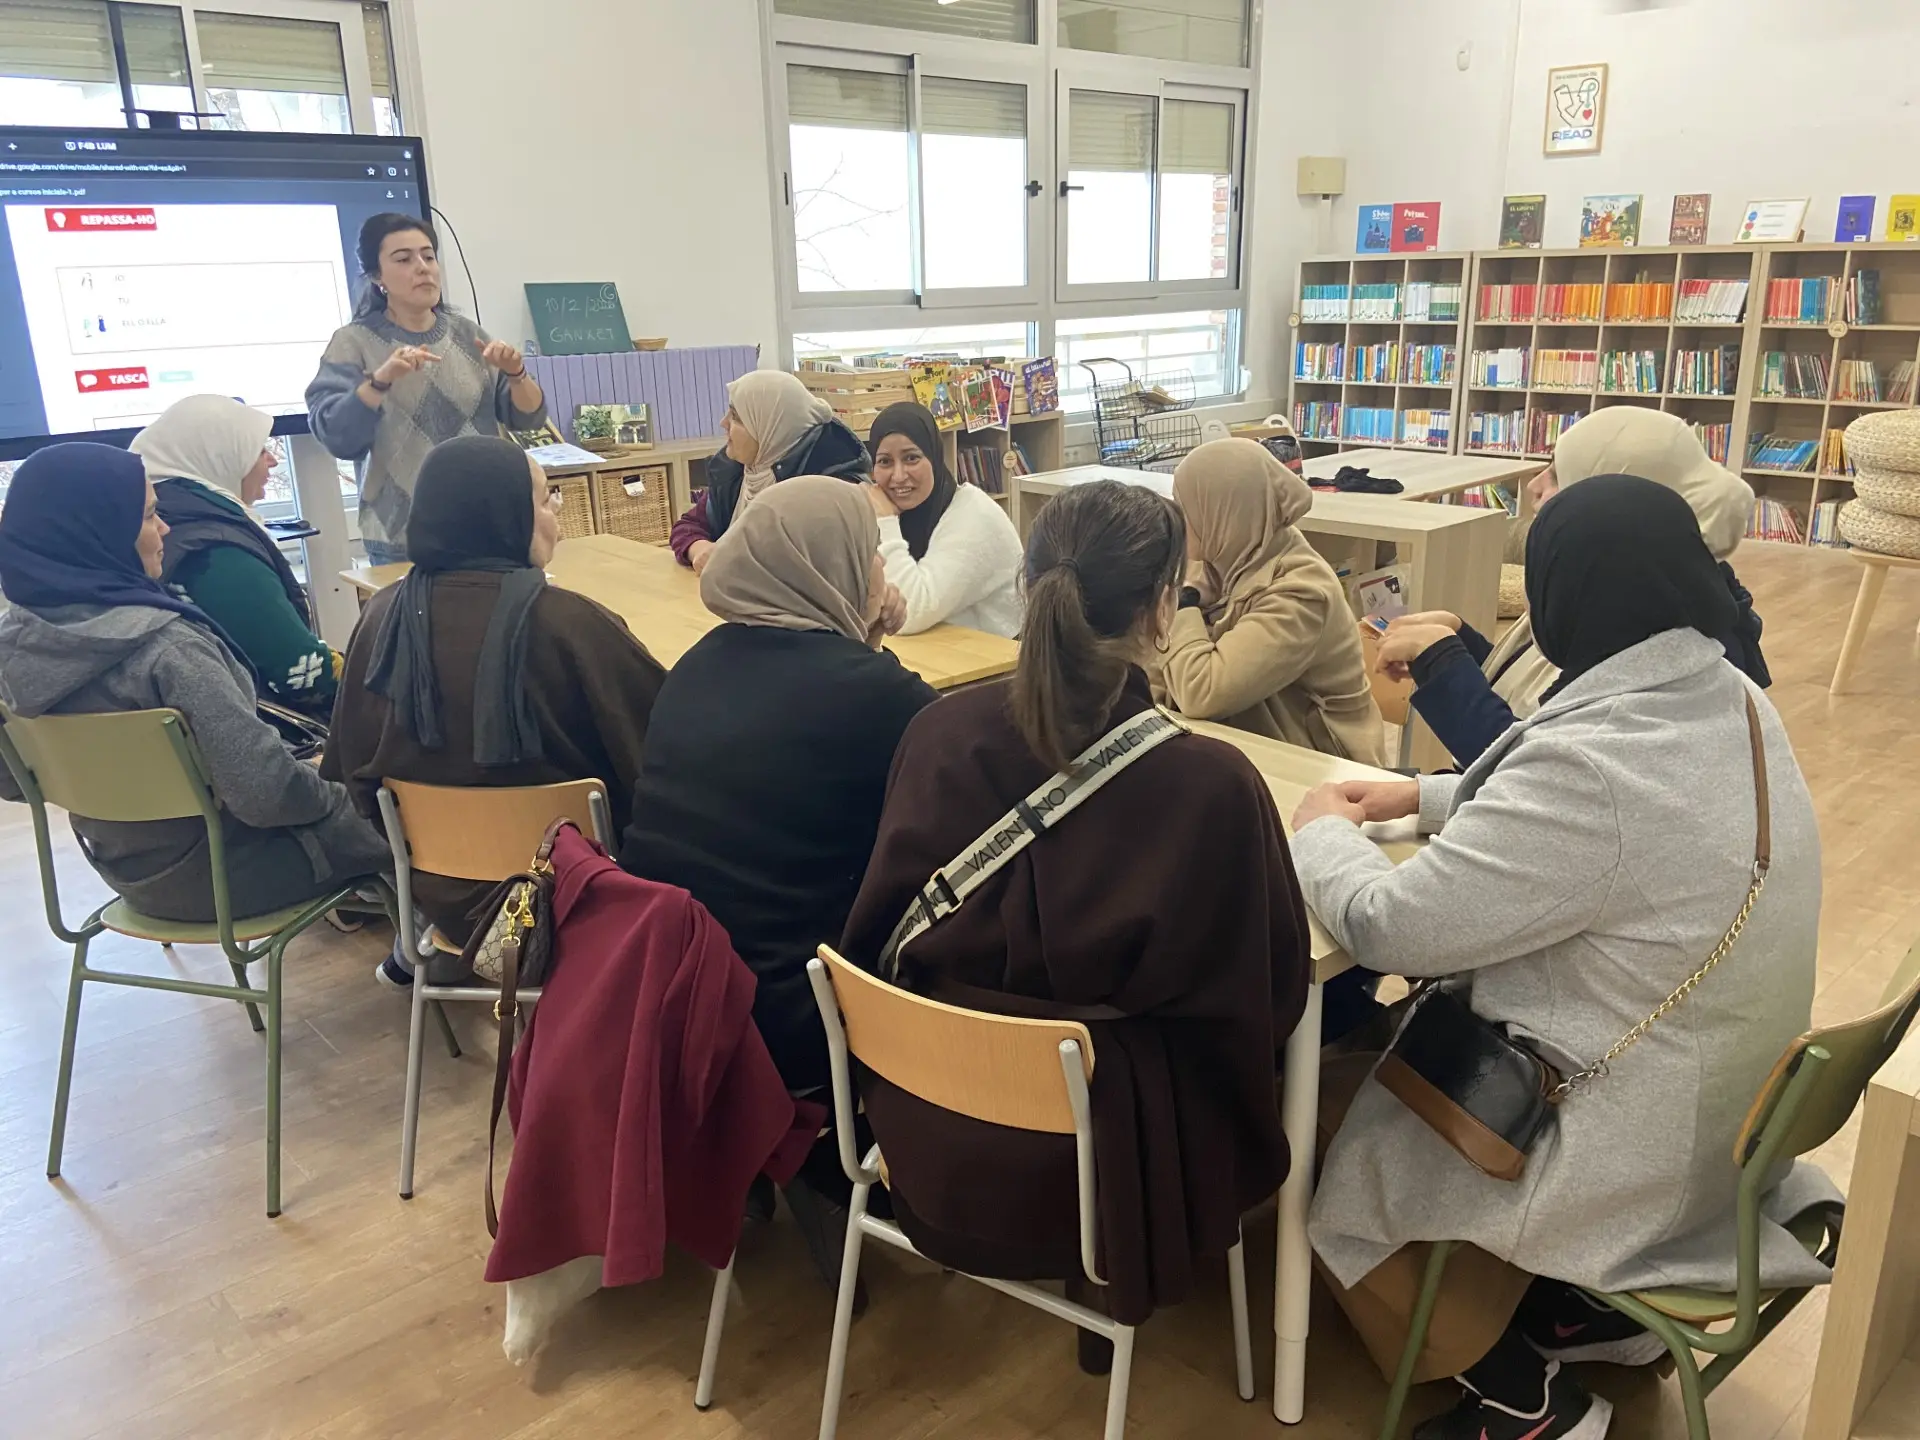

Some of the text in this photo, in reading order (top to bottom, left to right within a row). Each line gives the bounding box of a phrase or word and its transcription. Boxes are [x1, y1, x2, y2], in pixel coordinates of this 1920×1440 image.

[1552, 129, 1592, 141] READ
[81, 215, 155, 225] REPASSA-HO
[550, 327, 614, 343] GANXET
[109, 373, 148, 384] TASCA
